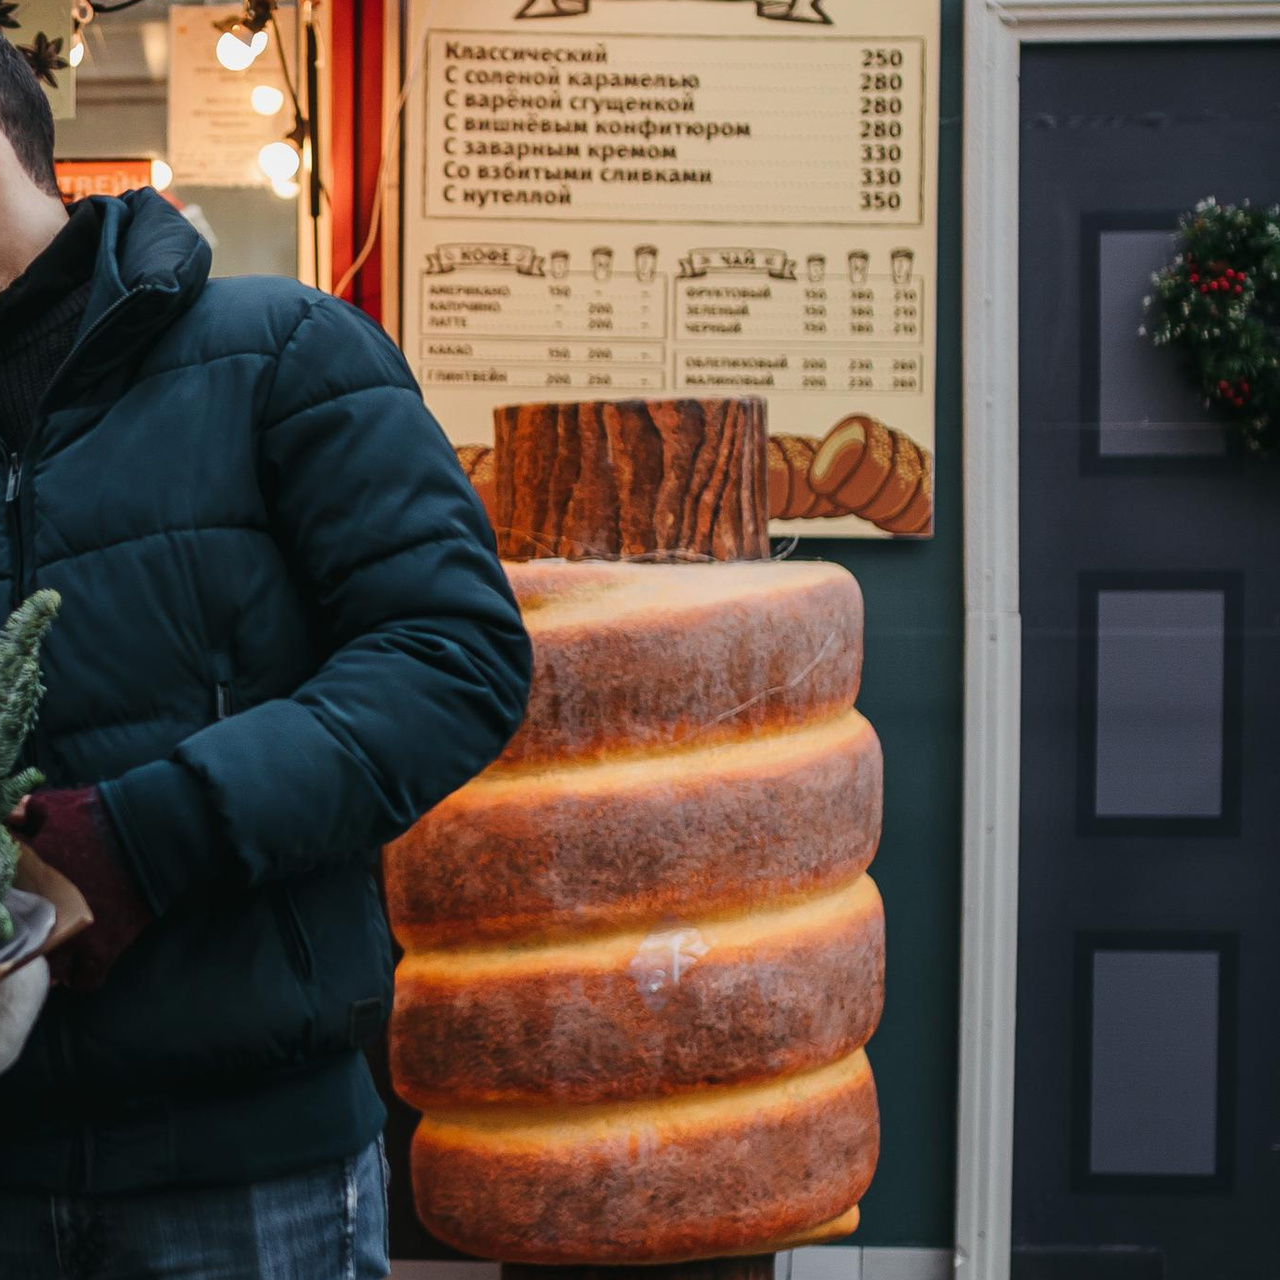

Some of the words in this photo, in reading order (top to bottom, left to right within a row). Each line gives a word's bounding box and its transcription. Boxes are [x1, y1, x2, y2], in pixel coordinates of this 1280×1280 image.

[445, 42, 608, 63] Классический
[861, 48, 903, 67] 250
[445, 65, 458, 84] С
[465, 66, 560, 85] соленой
[568, 72, 700, 91] карамелью
[860, 72, 903, 91] 280
[444, 89, 458, 108] С
[860, 96, 903, 115] 280
[444, 113, 458, 132] С
[595, 118, 752, 141] конфитюром
[860, 121, 902, 139] 280
[443, 136, 457, 155] С
[463, 140, 581, 160] заварным
[588, 144, 677, 163] кремом
[860, 144, 902, 162] 330
[443, 160, 471, 179] Со
[477, 163, 593, 182] взбитыми
[600, 168, 712, 184] сливками
[860, 168, 901, 186] 330
[442, 184, 456, 202] С
[463, 183, 572, 207] нутеллой
[859, 191, 901, 210] 350
[460, 247, 510, 262] КОФЕ
[720, 250, 756, 266] ЧАЙ
